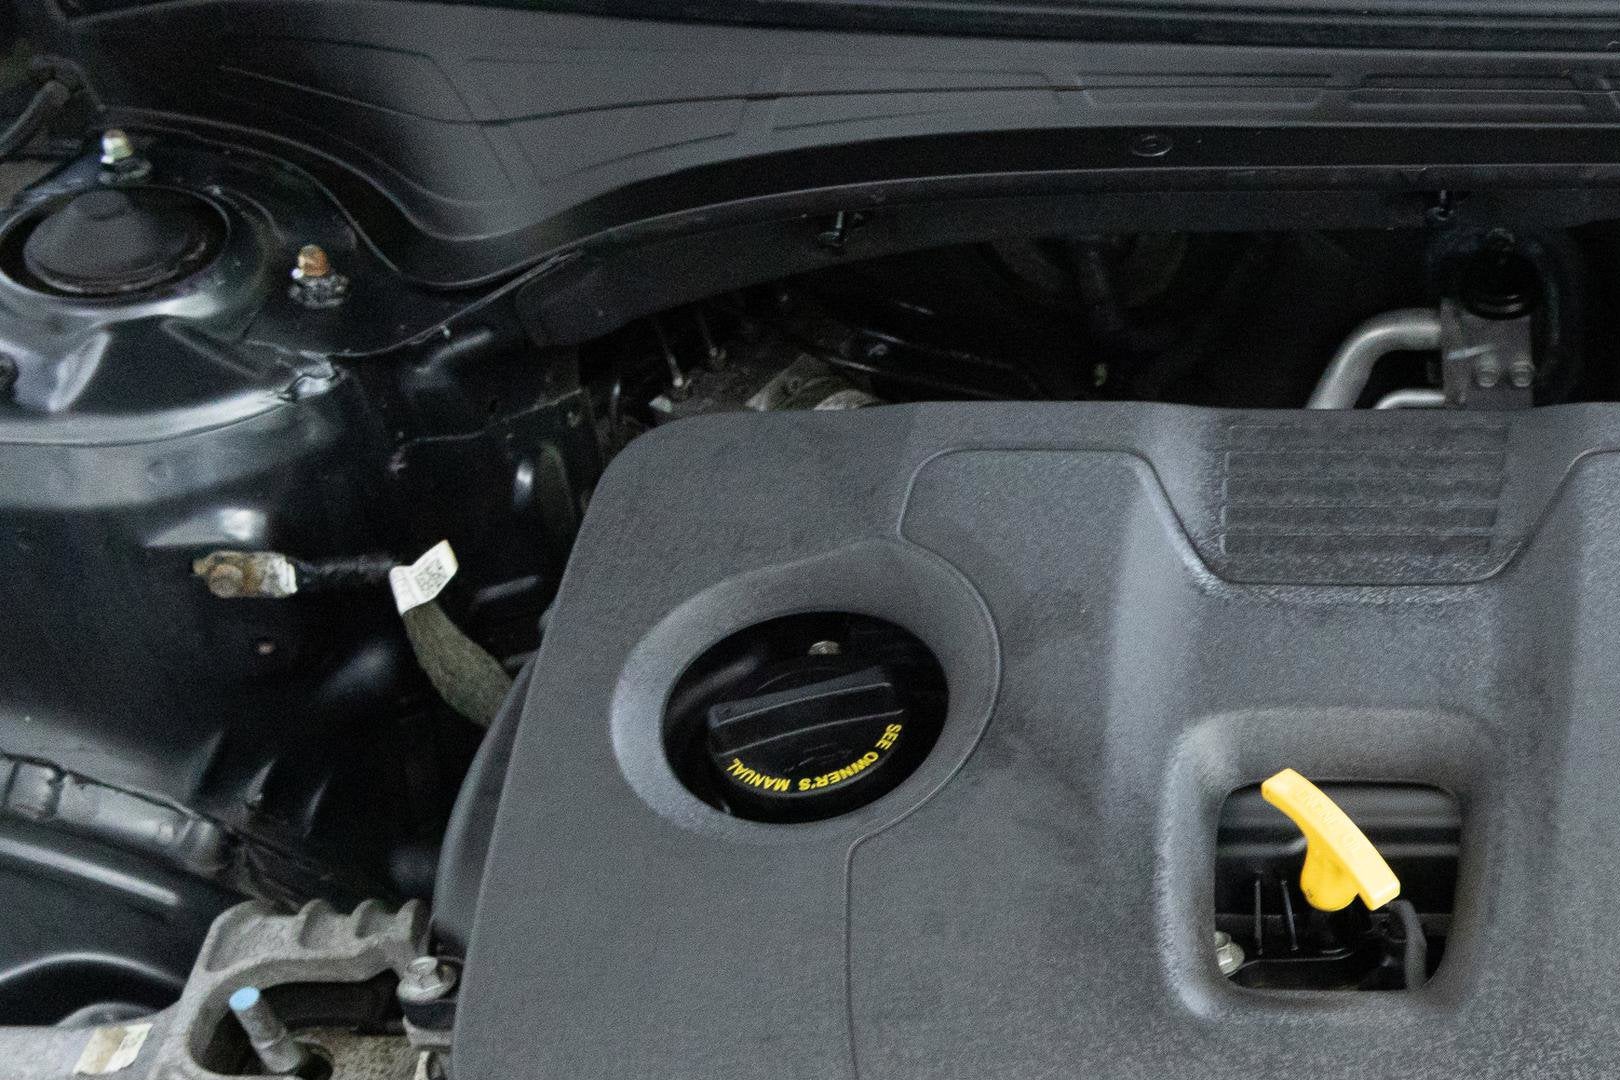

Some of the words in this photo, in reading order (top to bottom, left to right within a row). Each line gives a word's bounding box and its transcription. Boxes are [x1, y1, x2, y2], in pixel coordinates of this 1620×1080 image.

[874, 722, 904, 751] SEE
[726, 758, 790, 792] MANUAL
[797, 752, 880, 791] OWNER'S
